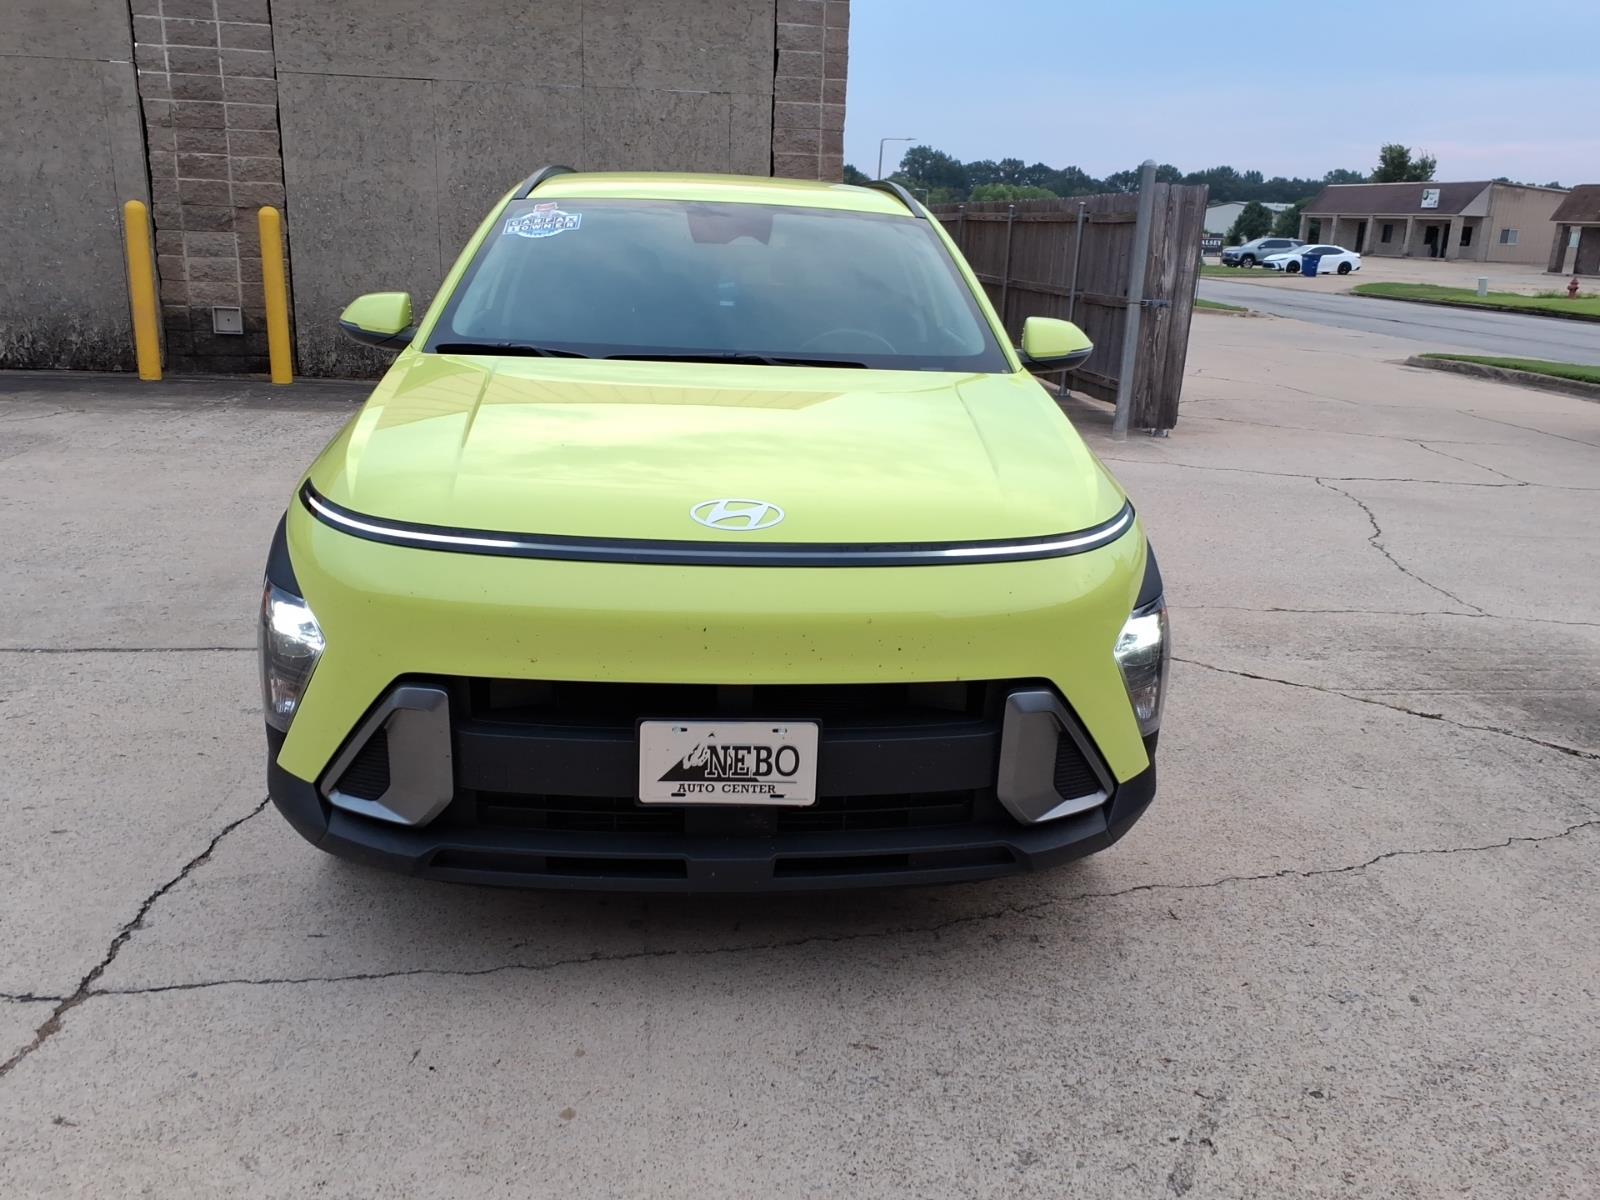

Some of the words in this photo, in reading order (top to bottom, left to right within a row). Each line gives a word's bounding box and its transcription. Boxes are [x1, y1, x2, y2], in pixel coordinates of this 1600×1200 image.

[511, 216, 577, 226] CARFAX
[706, 745, 800, 777] NEBO
[677, 783, 715, 793] AUTO
[722, 784, 776, 794] CENTER
